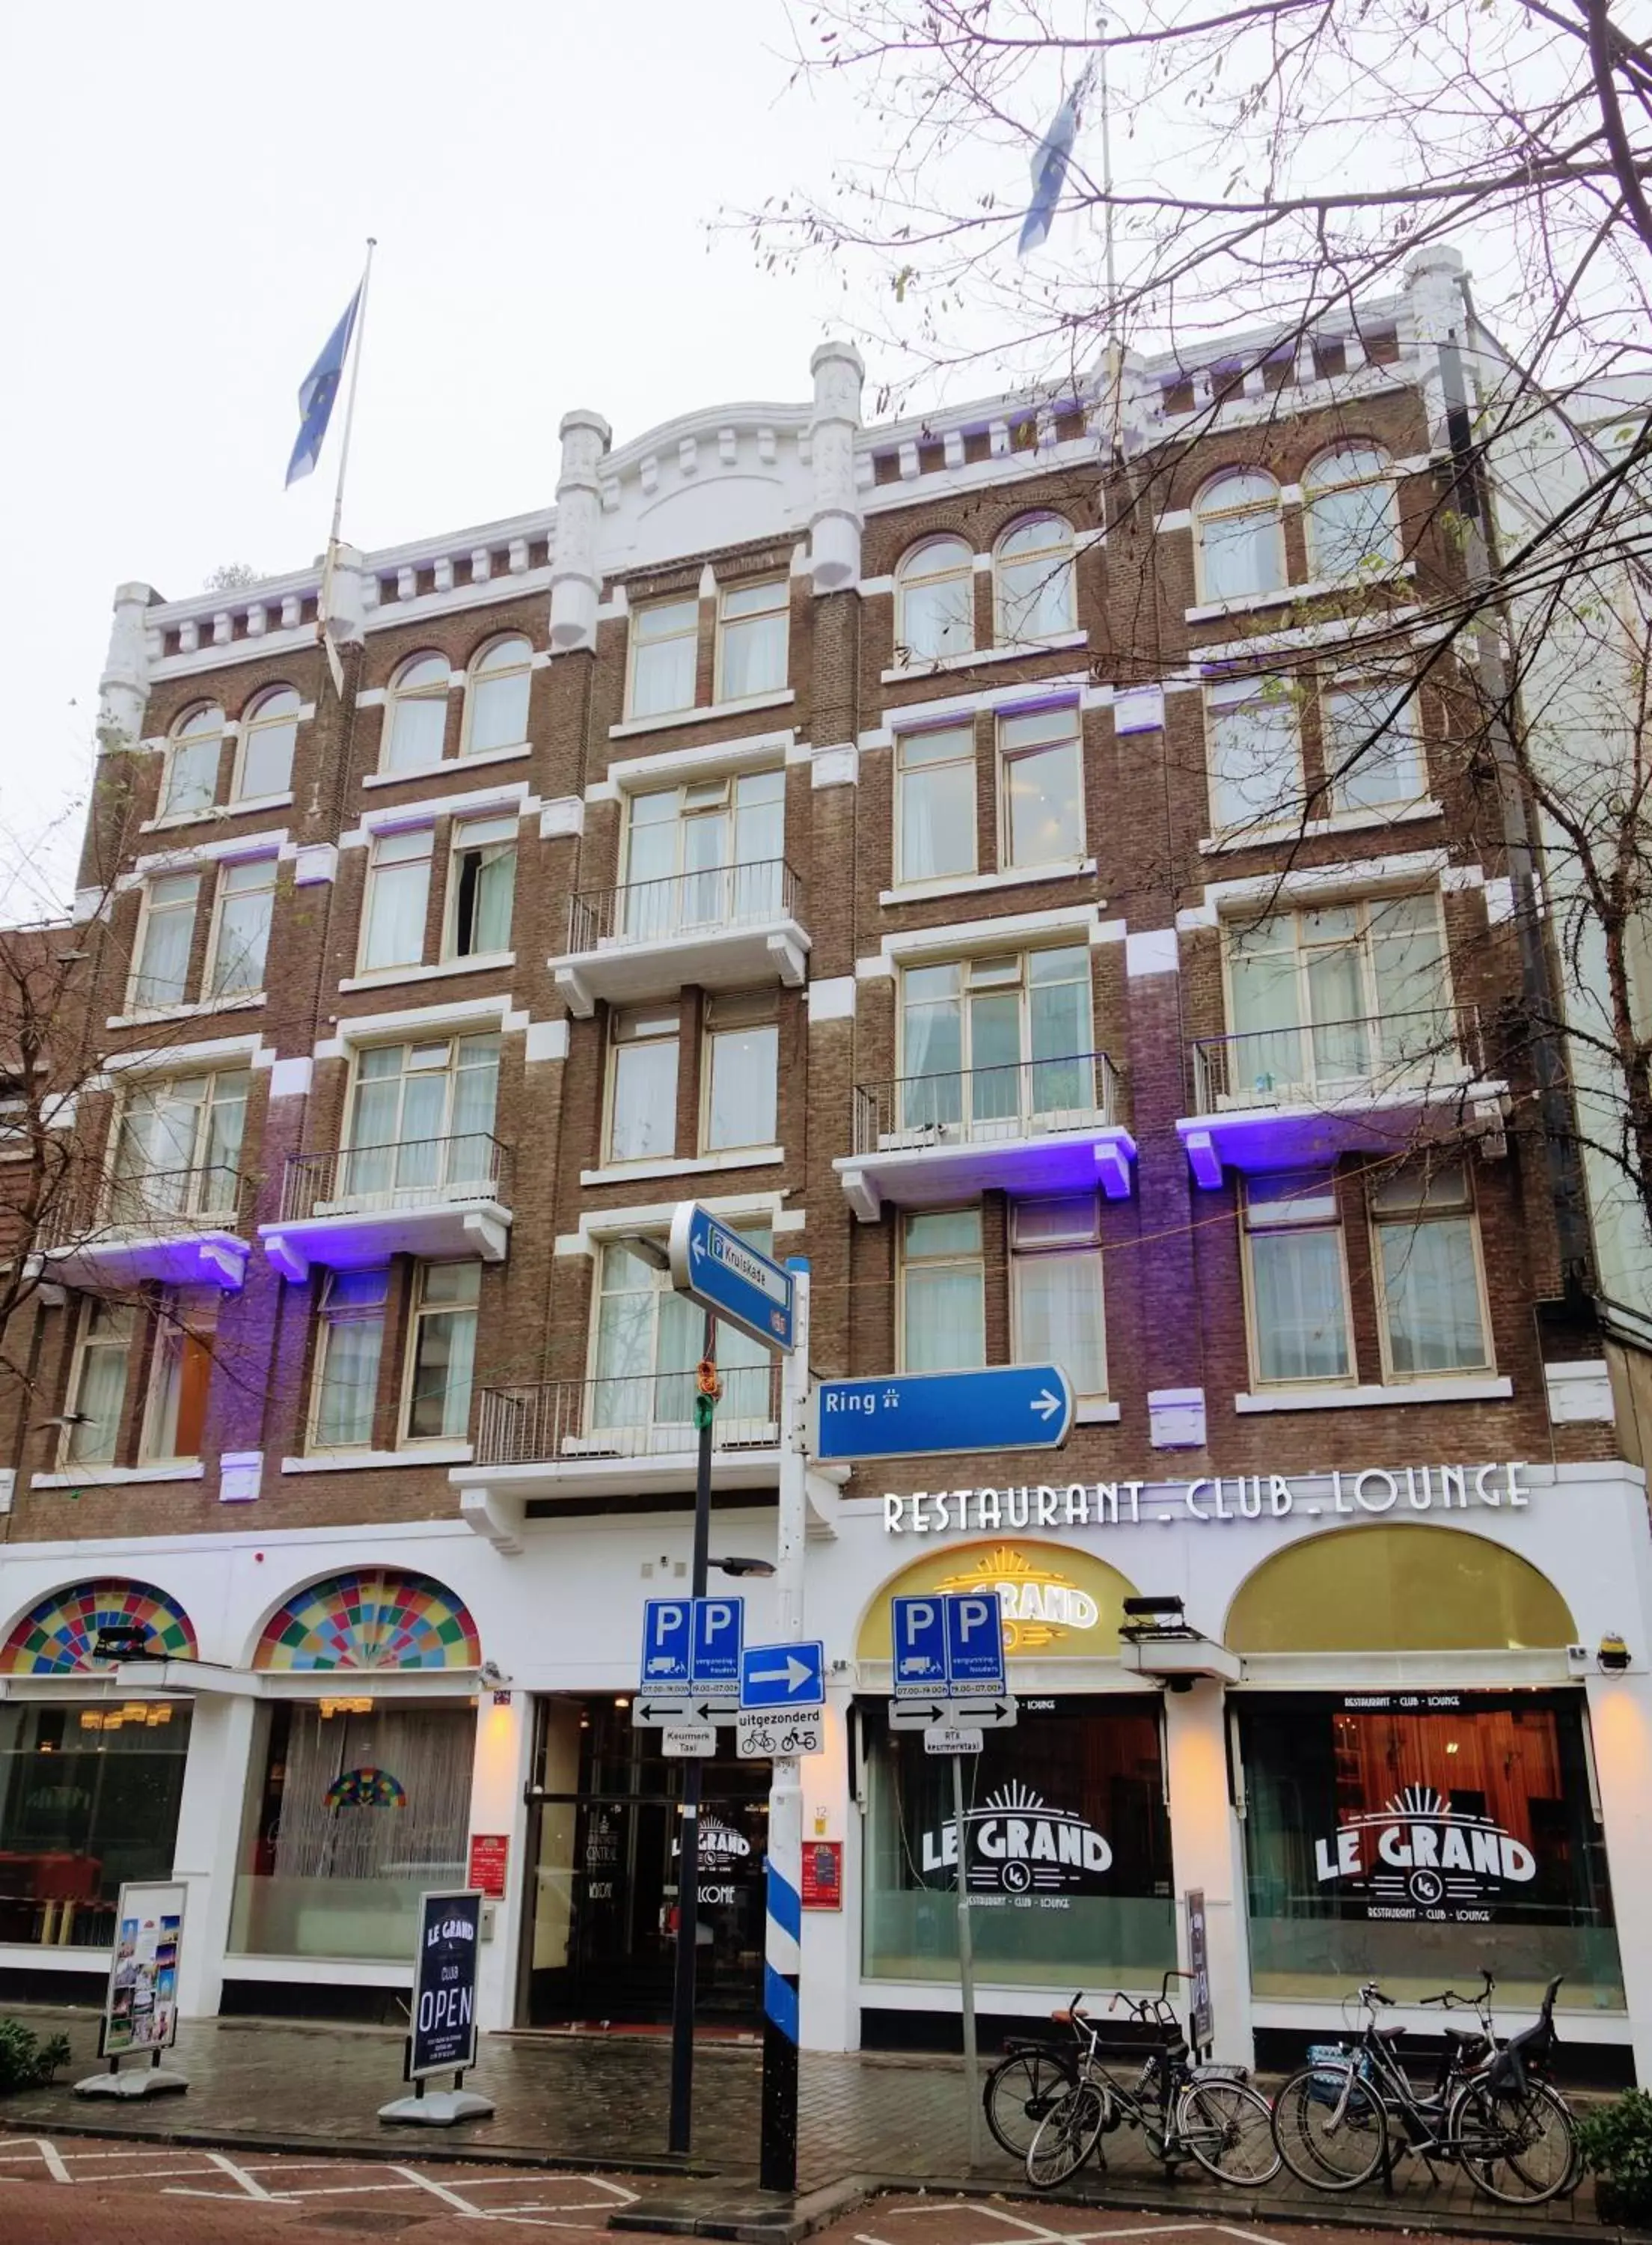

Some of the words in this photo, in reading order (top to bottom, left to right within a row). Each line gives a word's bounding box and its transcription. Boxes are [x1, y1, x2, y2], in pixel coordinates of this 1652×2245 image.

[725, 1243, 766, 1286] Kruiskade
[825, 1393, 876, 1414] Ring
[884, 1481, 1145, 1533] RESTAURANT
[1186, 1475, 1293, 1520] CLUB
[1333, 1461, 1530, 1512] LOUNGE
[970, 1582, 1099, 1629] RAND
[656, 1605, 682, 1646] P
[705, 1604, 732, 1644] P
[906, 1602, 935, 1646] P
[959, 1600, 988, 1643] P
[1027, 1699, 1056, 1710] LOUNGE
[1344, 1696, 1390, 1707] RESTAURANT
[1399, 1696, 1419, 1706] CLUB
[1428, 1695, 1460, 1706] LOUNGE
[739, 1709, 820, 1728] uitgezonderd
[667, 1732, 710, 1741] Keurmerk
[698, 1832, 750, 1857] GRAND
[923, 1825, 959, 1872] LE
[977, 1819, 1113, 1872] GRAND
[1315, 1831, 1362, 1882] LE
[1378, 1825, 1536, 1883] GRAND
[697, 1885, 735, 1905] LCOME
[964, 1896, 1006, 1907] ESTAURANT
[1015, 1896, 1032, 1908] CLUB
[1040, 1897, 1071, 1909] LOUNGE
[1367, 1907, 1416, 1919] RESTAURANT
[1427, 1908, 1446, 1920] CLUB
[1456, 1908, 1490, 1922] LOUNGE
[427, 1924, 440, 1946] LE
[442, 1919, 474, 1940] GRAND
[441, 1965, 459, 1982] CLUB
[419, 1985, 474, 2032] OPEN
